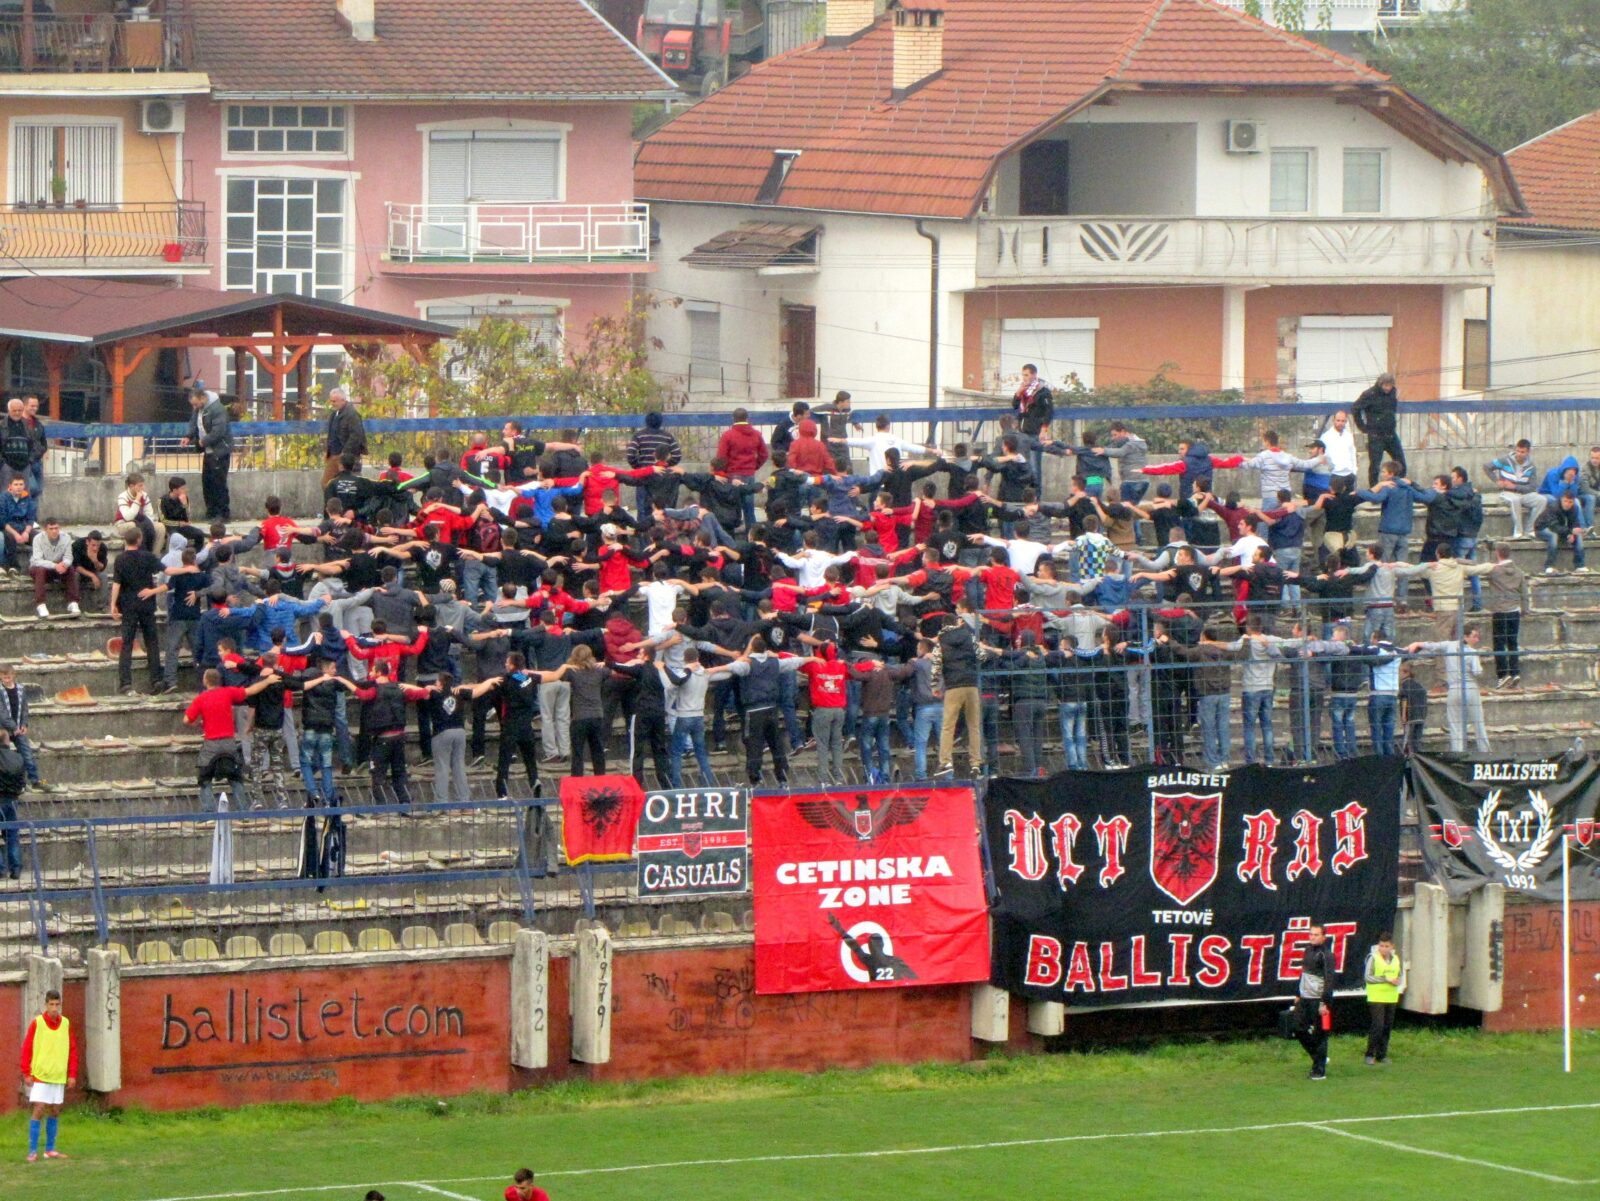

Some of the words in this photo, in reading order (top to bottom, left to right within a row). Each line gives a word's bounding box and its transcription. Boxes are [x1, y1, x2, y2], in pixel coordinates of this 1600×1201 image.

[1147, 771, 1231, 788] BALLISTET
[1473, 759, 1558, 780] BALLISTËT
[645, 791, 740, 822] OHRI
[644, 858, 741, 889] CASUALS
[776, 855, 952, 886] CETINSKA
[1504, 874, 1537, 889] 1992
[818, 884, 912, 909] ZONE
[1152, 909, 1214, 925] TETOVË
[1024, 916, 1357, 992] BALLISTËT
[875, 968, 894, 981] 22
[162, 987, 464, 1049] ballistet.com
